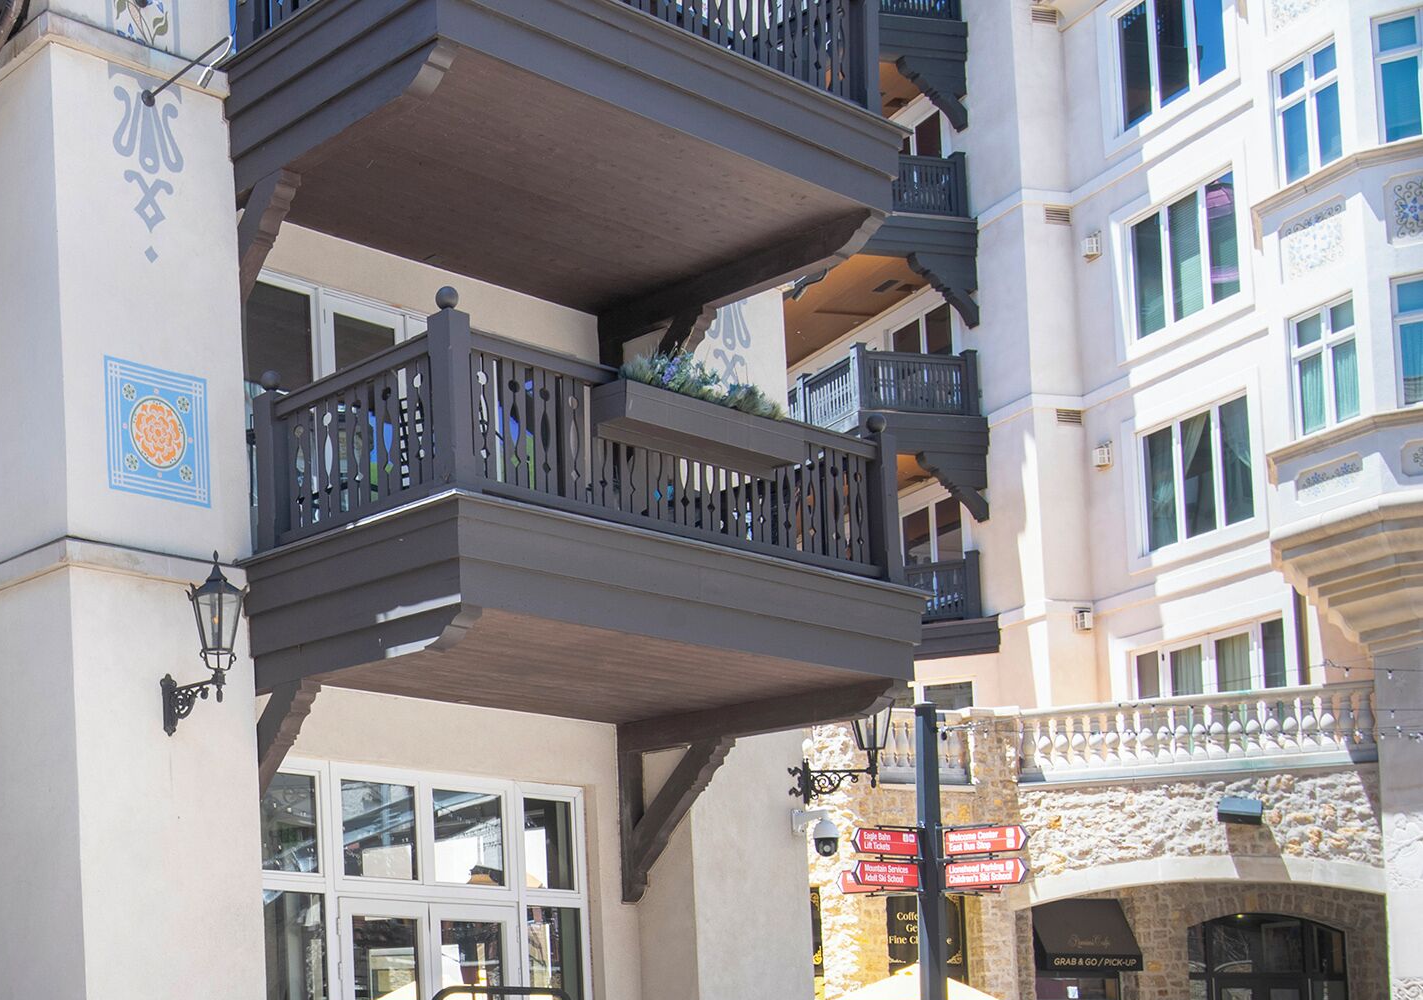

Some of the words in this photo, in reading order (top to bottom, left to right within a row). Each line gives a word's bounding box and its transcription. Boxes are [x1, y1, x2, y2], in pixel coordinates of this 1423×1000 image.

[863, 831, 878, 841] Eagle
[878, 832, 892, 841] Bahn
[948, 833, 977, 841] Welcome
[977, 831, 999, 839] Center
[863, 841, 873, 849] Lift
[873, 842, 891, 850] Tickets
[948, 843, 963, 852] East
[963, 842, 976, 850] Bus
[976, 841, 991, 850] Stop
[864, 864, 887, 872] Mountain
[887, 865, 909, 874] Services
[864, 873, 878, 881] Adult
[878, 873, 887, 882] Ski
[887, 874, 904, 883] School
[979, 872, 990, 882] Ski
[990, 871, 1013, 881] School
[888, 935, 908, 944] Fine
[1053, 957, 1077, 966] GRAB
[1077, 957, 1084, 966] &
[1084, 958, 1098, 966] GO
[1104, 958, 1137, 967] PICK-UP
